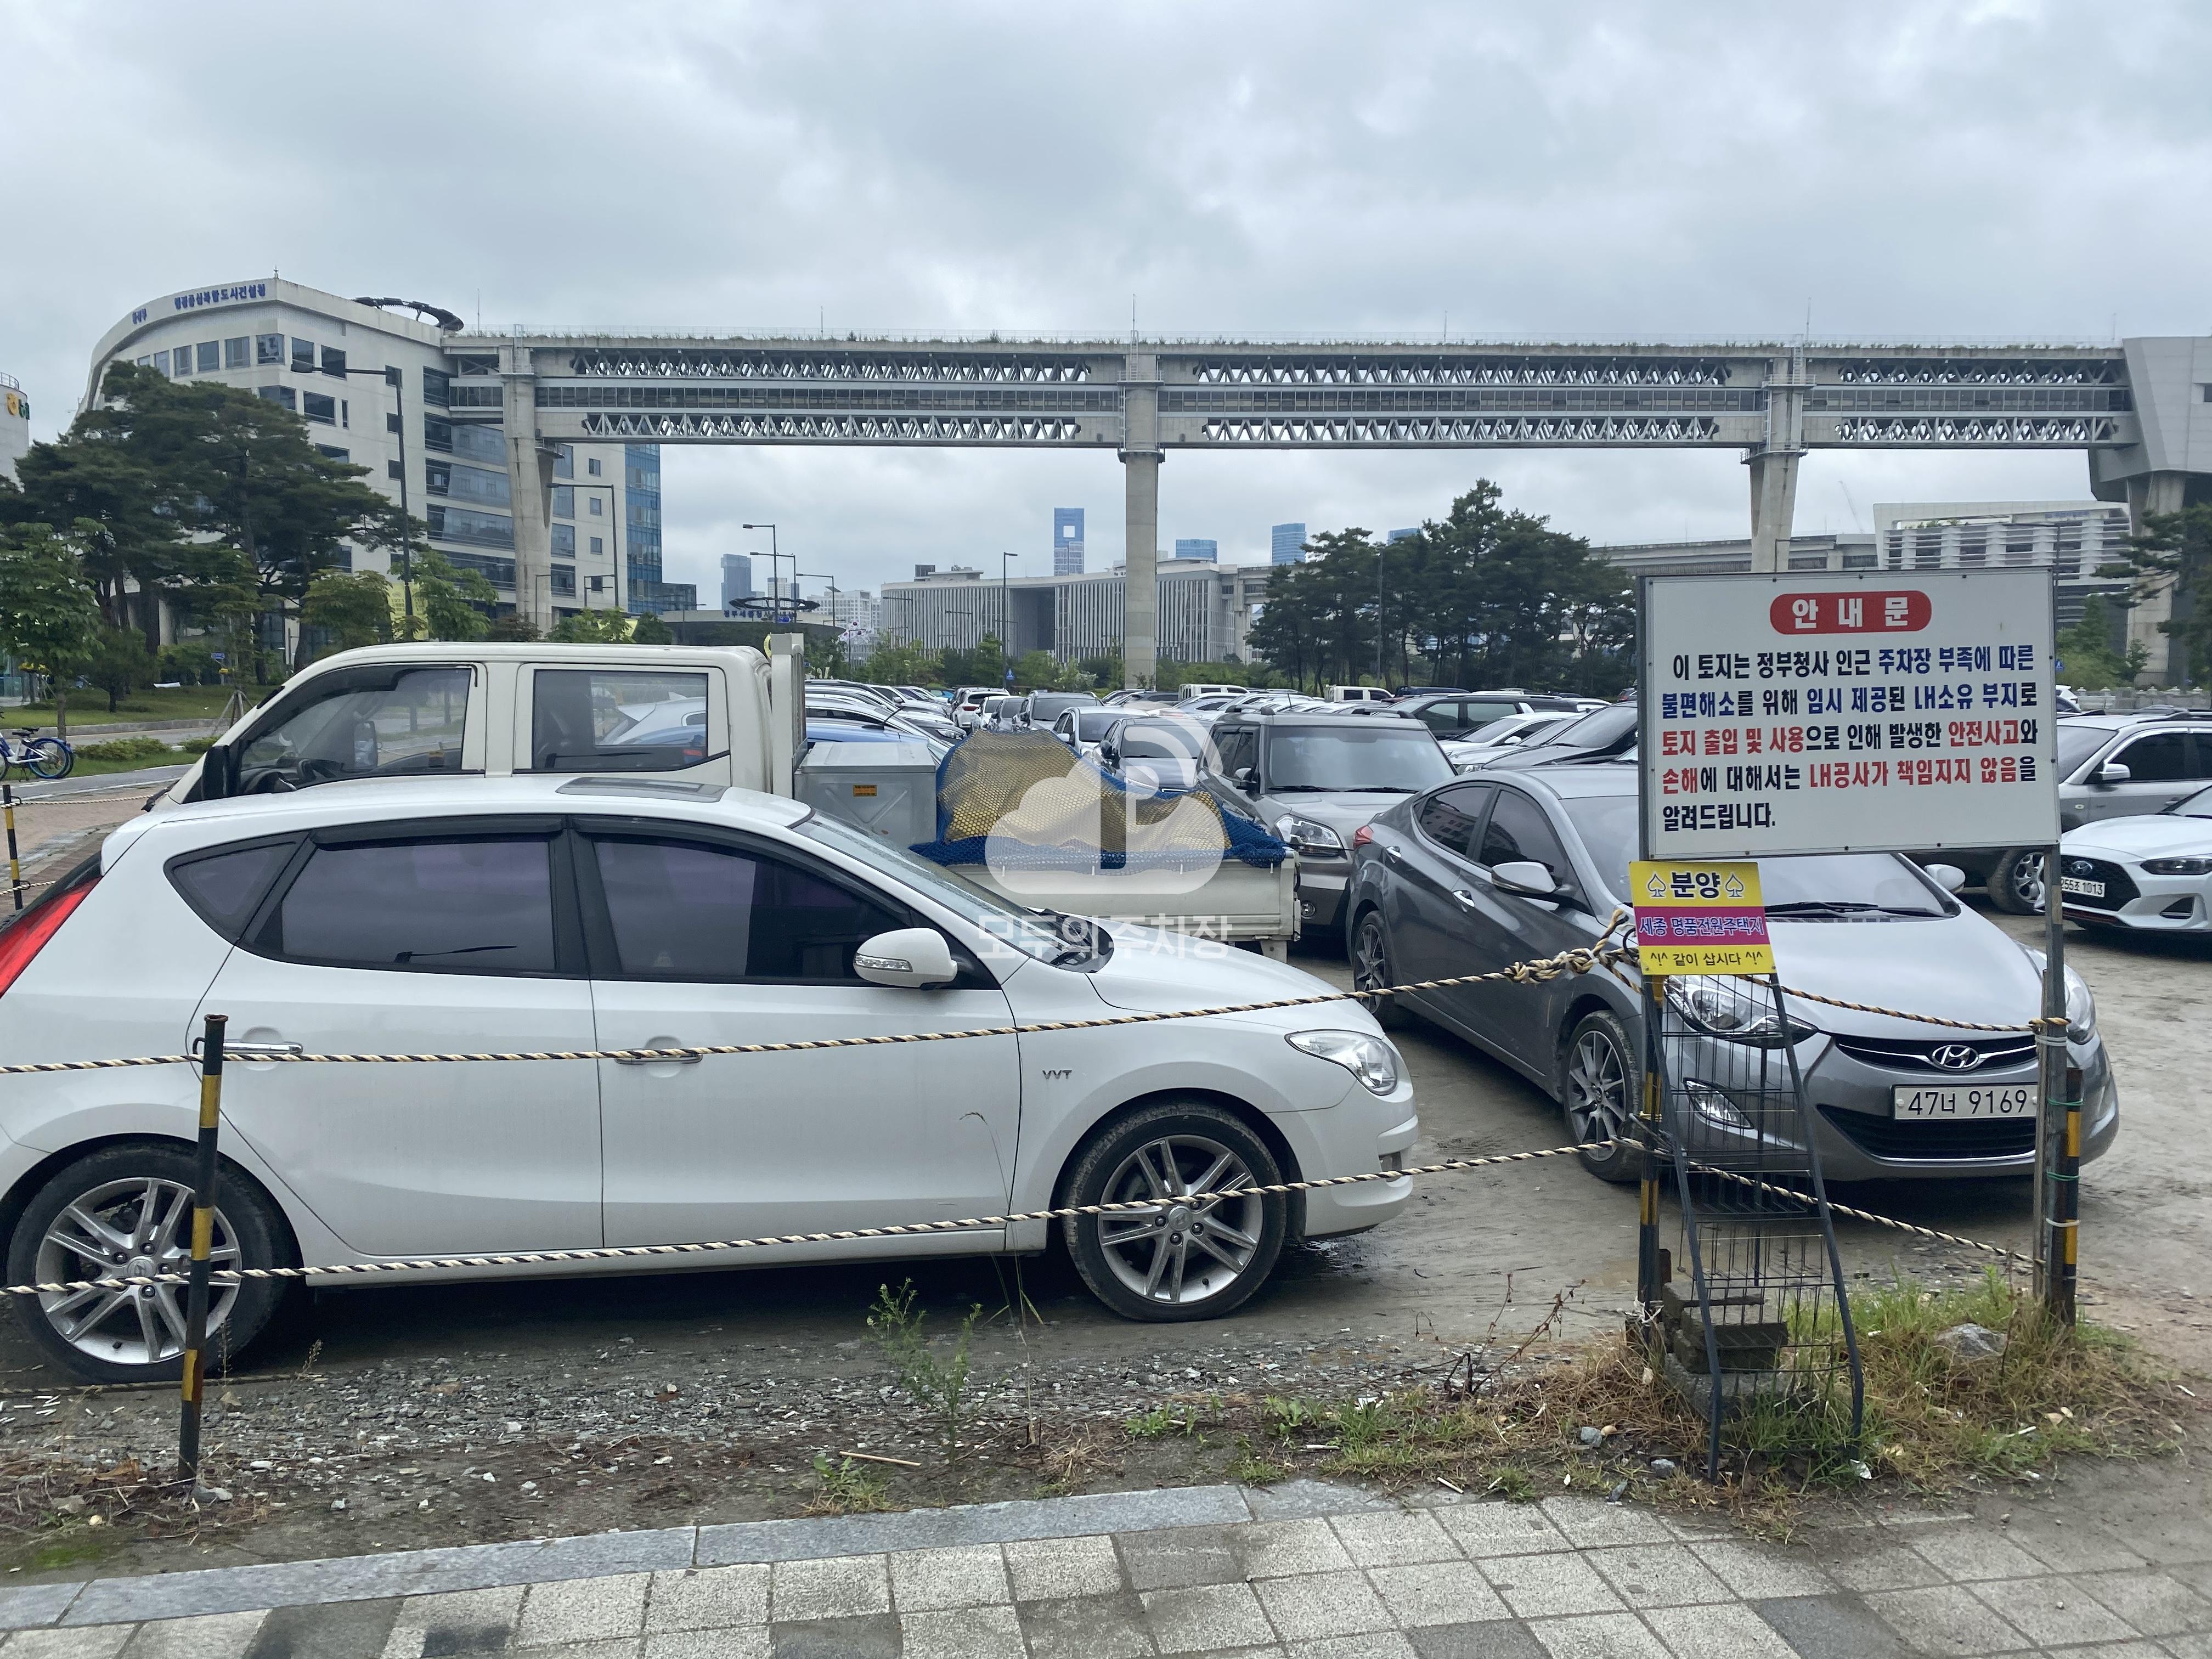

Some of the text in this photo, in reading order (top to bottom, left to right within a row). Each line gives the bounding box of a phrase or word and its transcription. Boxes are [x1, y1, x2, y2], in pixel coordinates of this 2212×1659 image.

[1673, 645, 2034, 681] 이 토지는 정부청사 인근 주차장 부족에 따른
[1662, 692, 1754, 719] 불편해소를
[1763, 690, 1798, 715] 위해
[1808, 688, 1842, 714] 임시
[1852, 686, 1905, 713] 제공된
[1983, 682, 2038, 709] 부지로
[1663, 719, 2039, 756] 토지 출입 및 사용으로 인해 발생한 안전사고와
[1663, 767, 1718, 794] 손해에
[1727, 765, 1801, 792] 대해서는
[1898, 759, 1971, 786] 책임지지
[1981, 756, 2036, 783] 않음을
[1663, 803, 1776, 832] 알려드립니다.
[1671, 872, 1721, 899] 분양
[1639, 917, 1667, 935] 세종
[1673, 953, 1699, 966] 같이
[1703, 952, 1741, 966] 삽시다
[1042, 1070, 1072, 1079] VVT
[1908, 1089, 2027, 1115] 47너 9169
